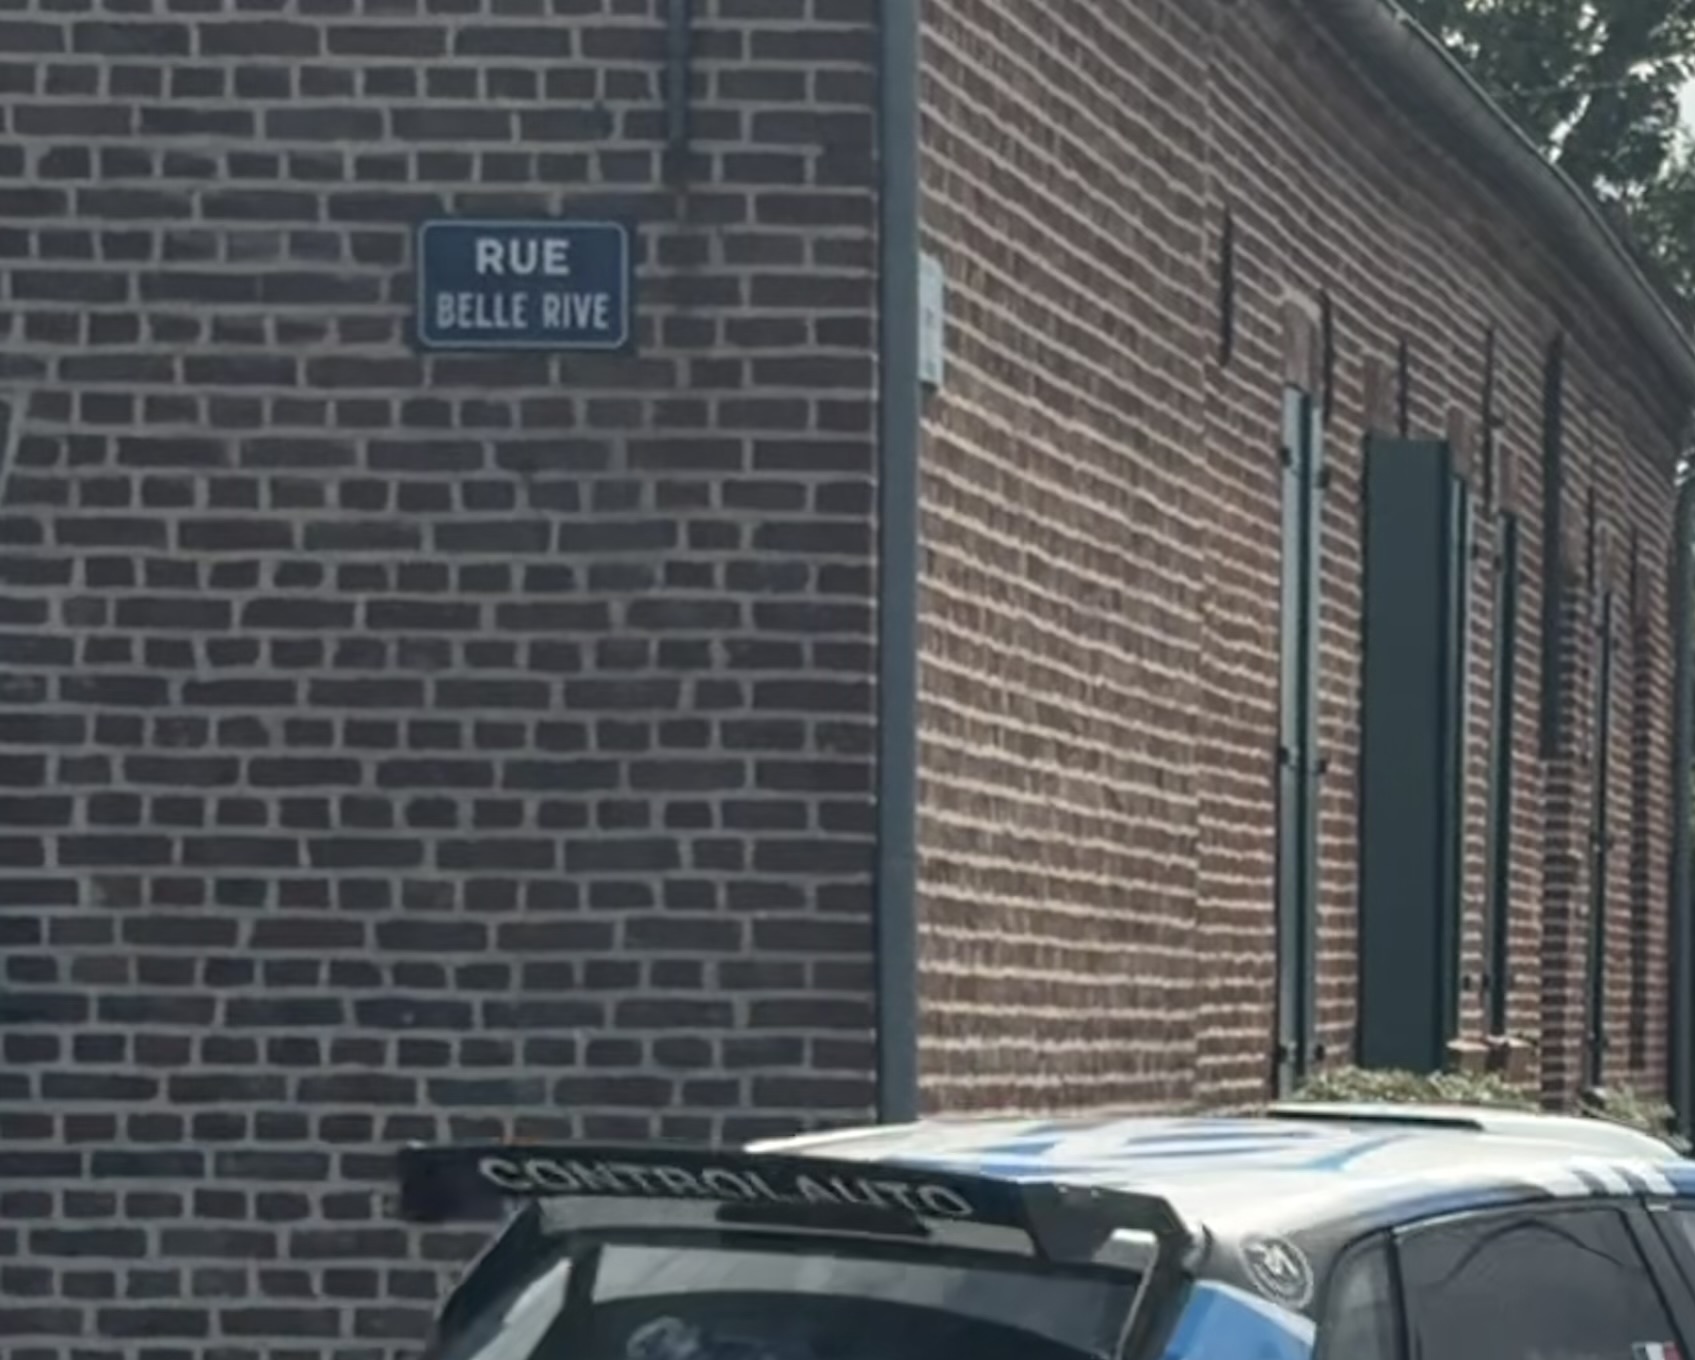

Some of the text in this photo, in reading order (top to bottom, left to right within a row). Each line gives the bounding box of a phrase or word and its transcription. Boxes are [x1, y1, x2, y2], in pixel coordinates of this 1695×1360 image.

[475, 238, 571, 276] RUE
[436, 292, 610, 330] BELLE RIVE
[796, 1173, 975, 1218] AUTO
